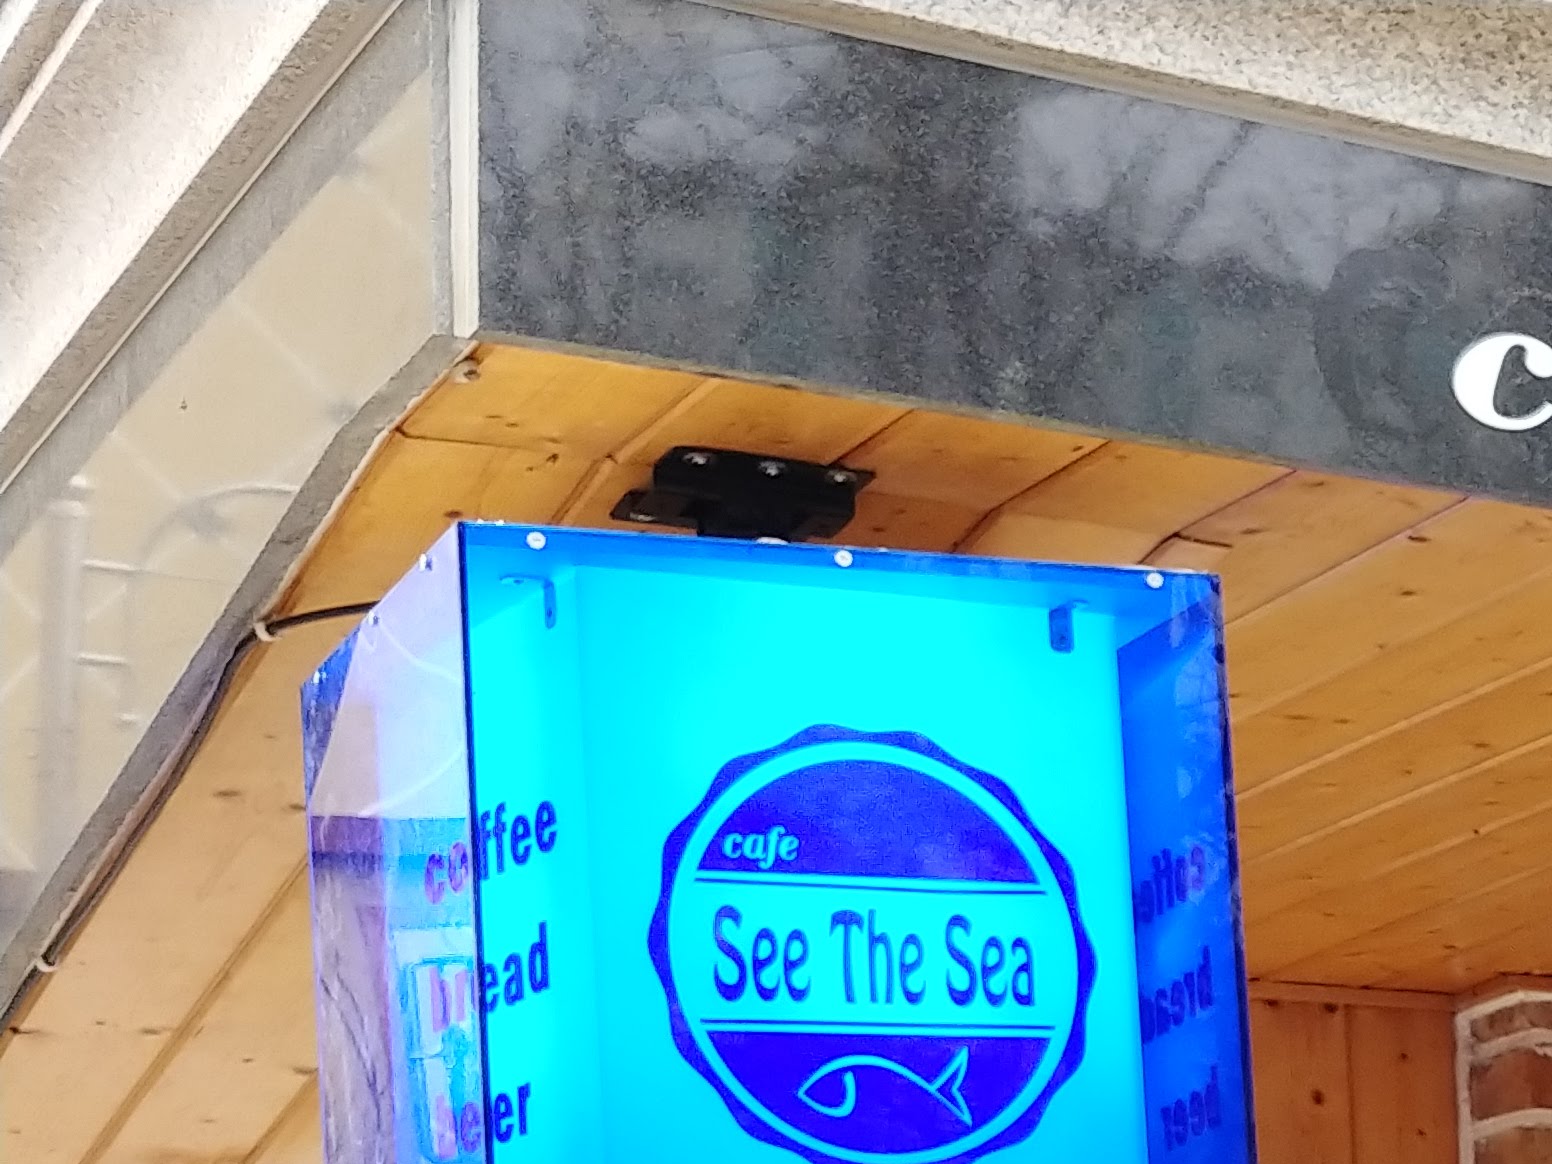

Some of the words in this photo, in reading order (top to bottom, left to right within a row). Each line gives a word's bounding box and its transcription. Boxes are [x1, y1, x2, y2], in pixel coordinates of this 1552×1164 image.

[424, 801, 558, 905] coffee
[724, 825, 798, 871] cafe
[714, 905, 809, 1004] See
[831, 909, 923, 1005] The
[946, 914, 1035, 1007] Sea
